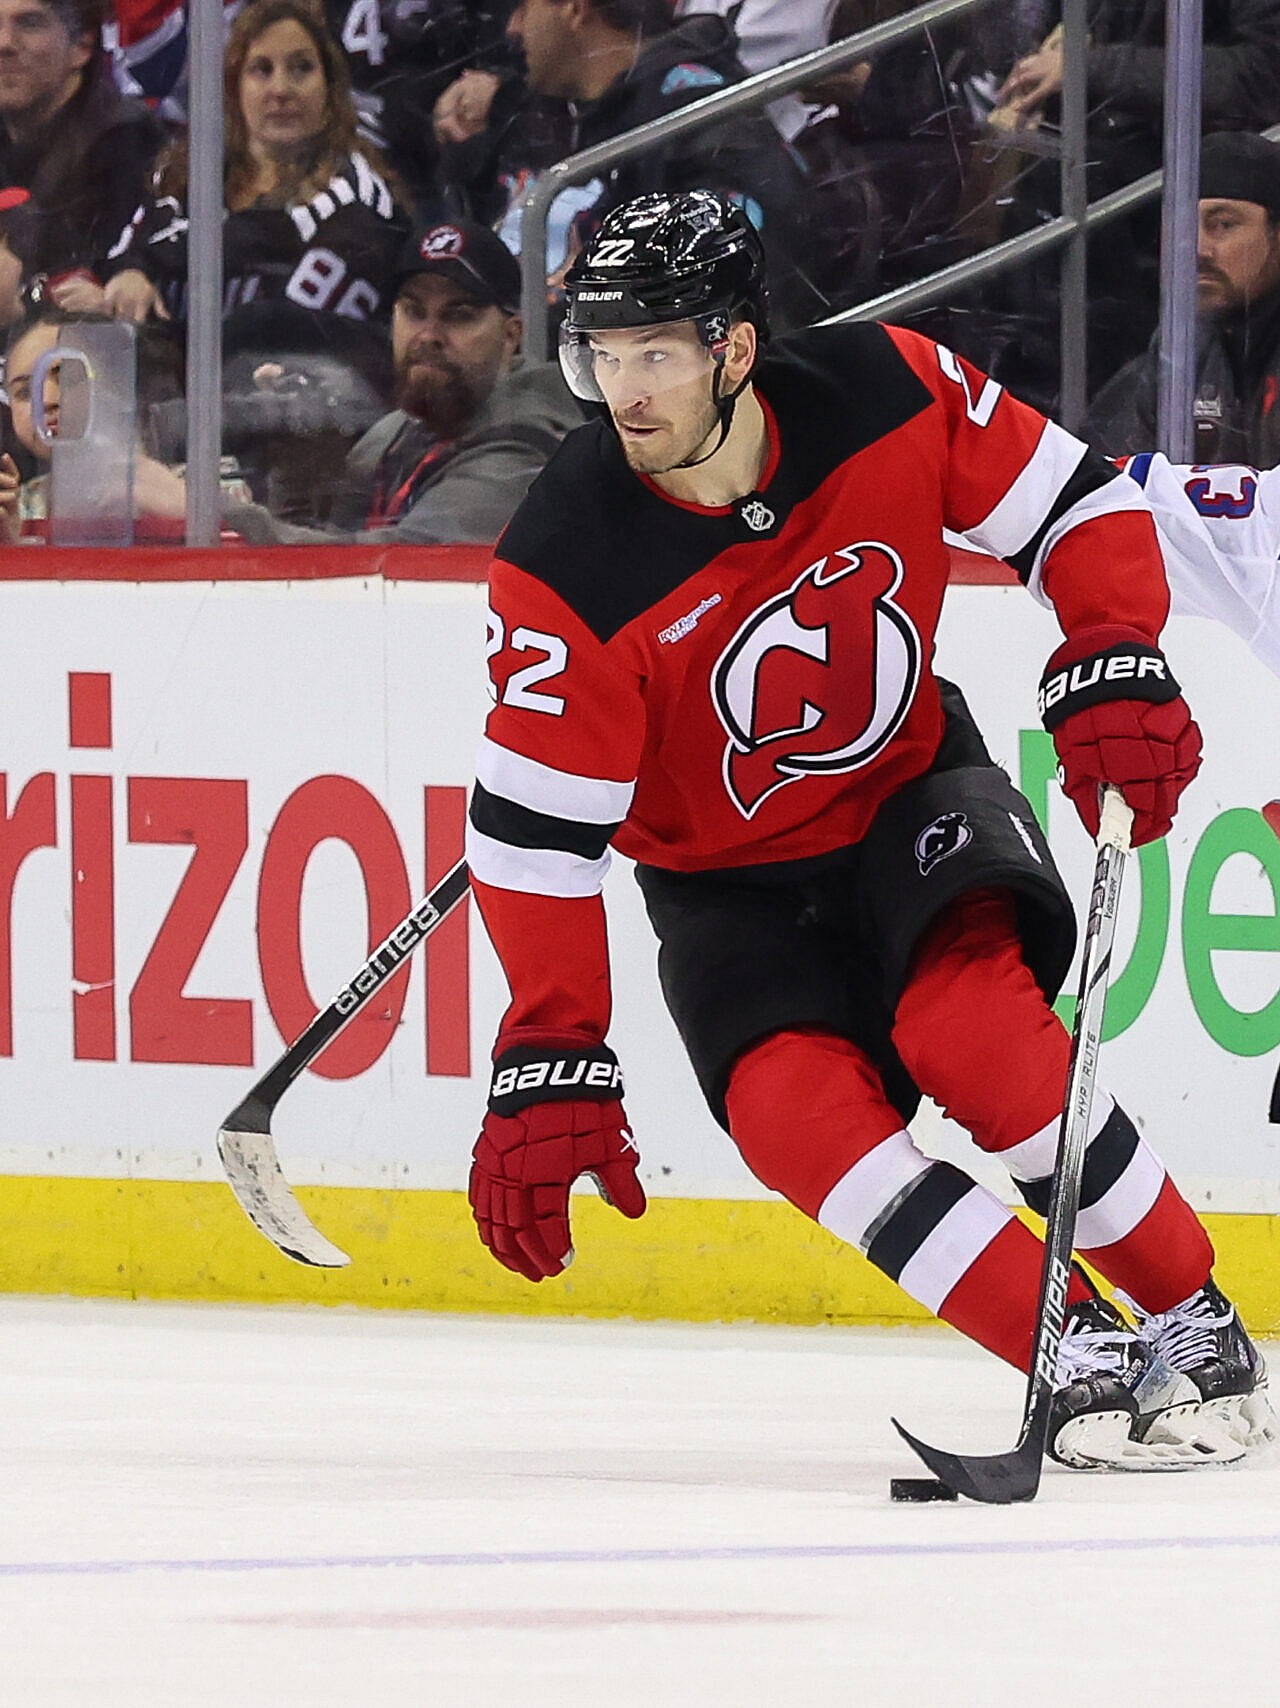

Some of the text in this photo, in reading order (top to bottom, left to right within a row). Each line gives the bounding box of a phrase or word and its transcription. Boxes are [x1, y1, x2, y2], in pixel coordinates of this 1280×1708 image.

[588, 239, 635, 268] 22
[577, 291, 623, 302] BAUER
[1184, 463, 1259, 519] 3
[1076, 1030, 1097, 1119] HYPRLITE
